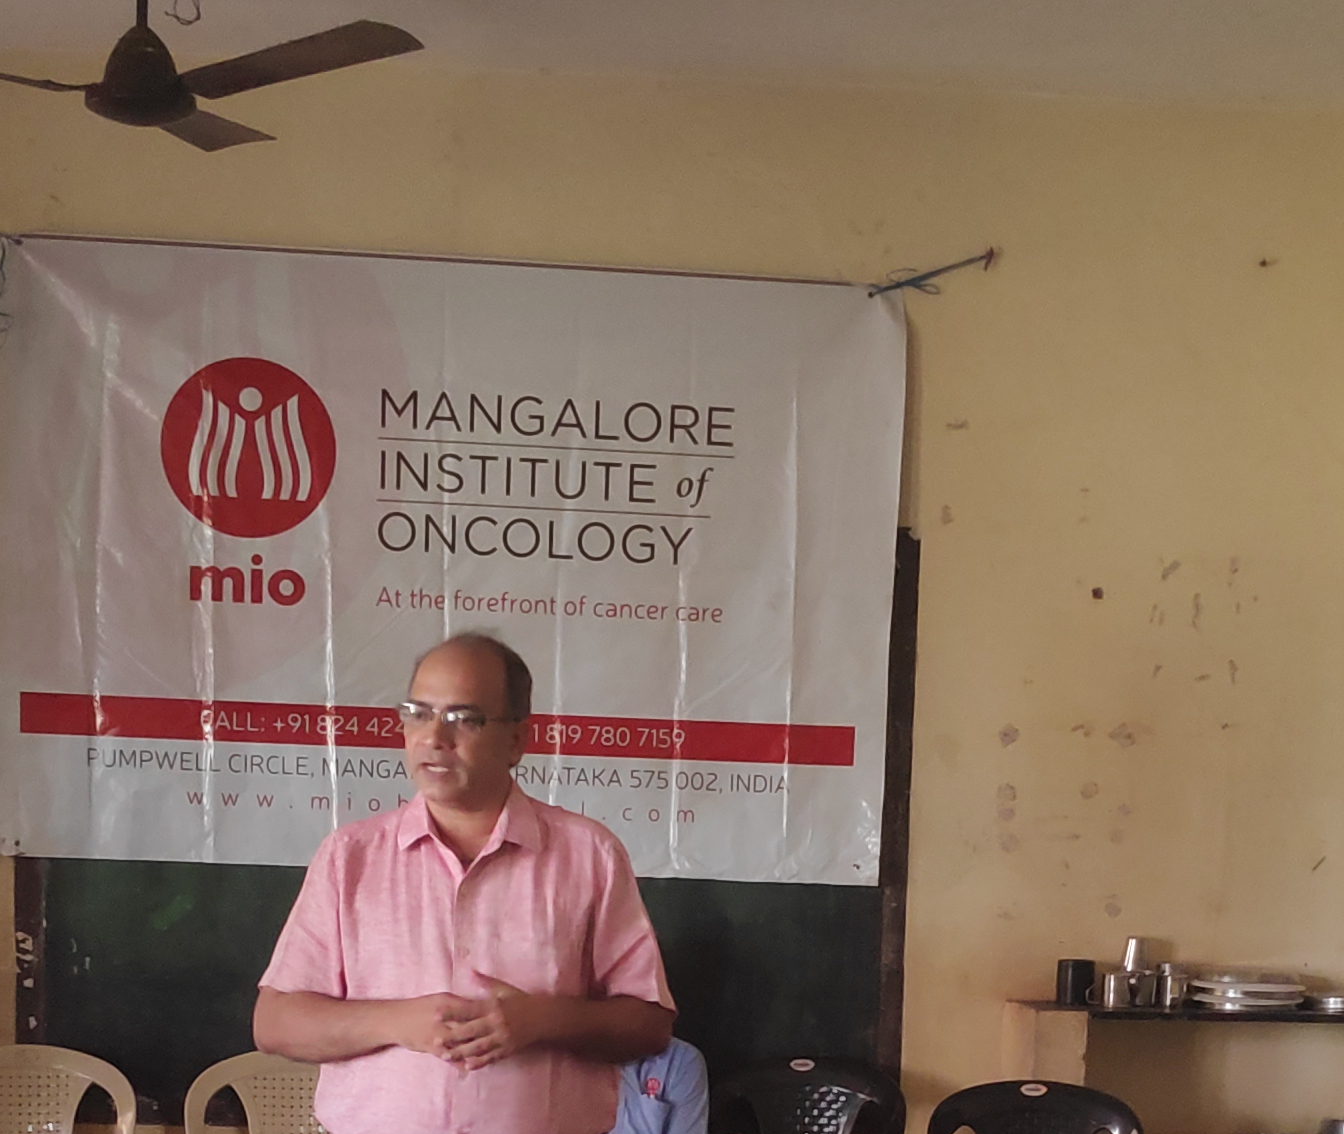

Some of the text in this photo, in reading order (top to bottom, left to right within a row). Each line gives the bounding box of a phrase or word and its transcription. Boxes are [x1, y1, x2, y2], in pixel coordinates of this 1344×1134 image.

[380, 388, 736, 447] MANGALORE
[378, 450, 714, 507] INSTITUTE of
[377, 512, 694, 565] ONCOLOGY
[190, 554, 305, 606] mio
[375, 586, 724, 624] At the forefront of cancer care
[587, 725, 631, 747] 780
[636, 728, 685, 749] 7159
[86, 747, 408, 780] PUMPWELL CIRCLE, MANGA
[515, 766, 623, 788] RNATAKA
[629, 769, 669, 790] 575
[730, 773, 790, 795] INDIA
